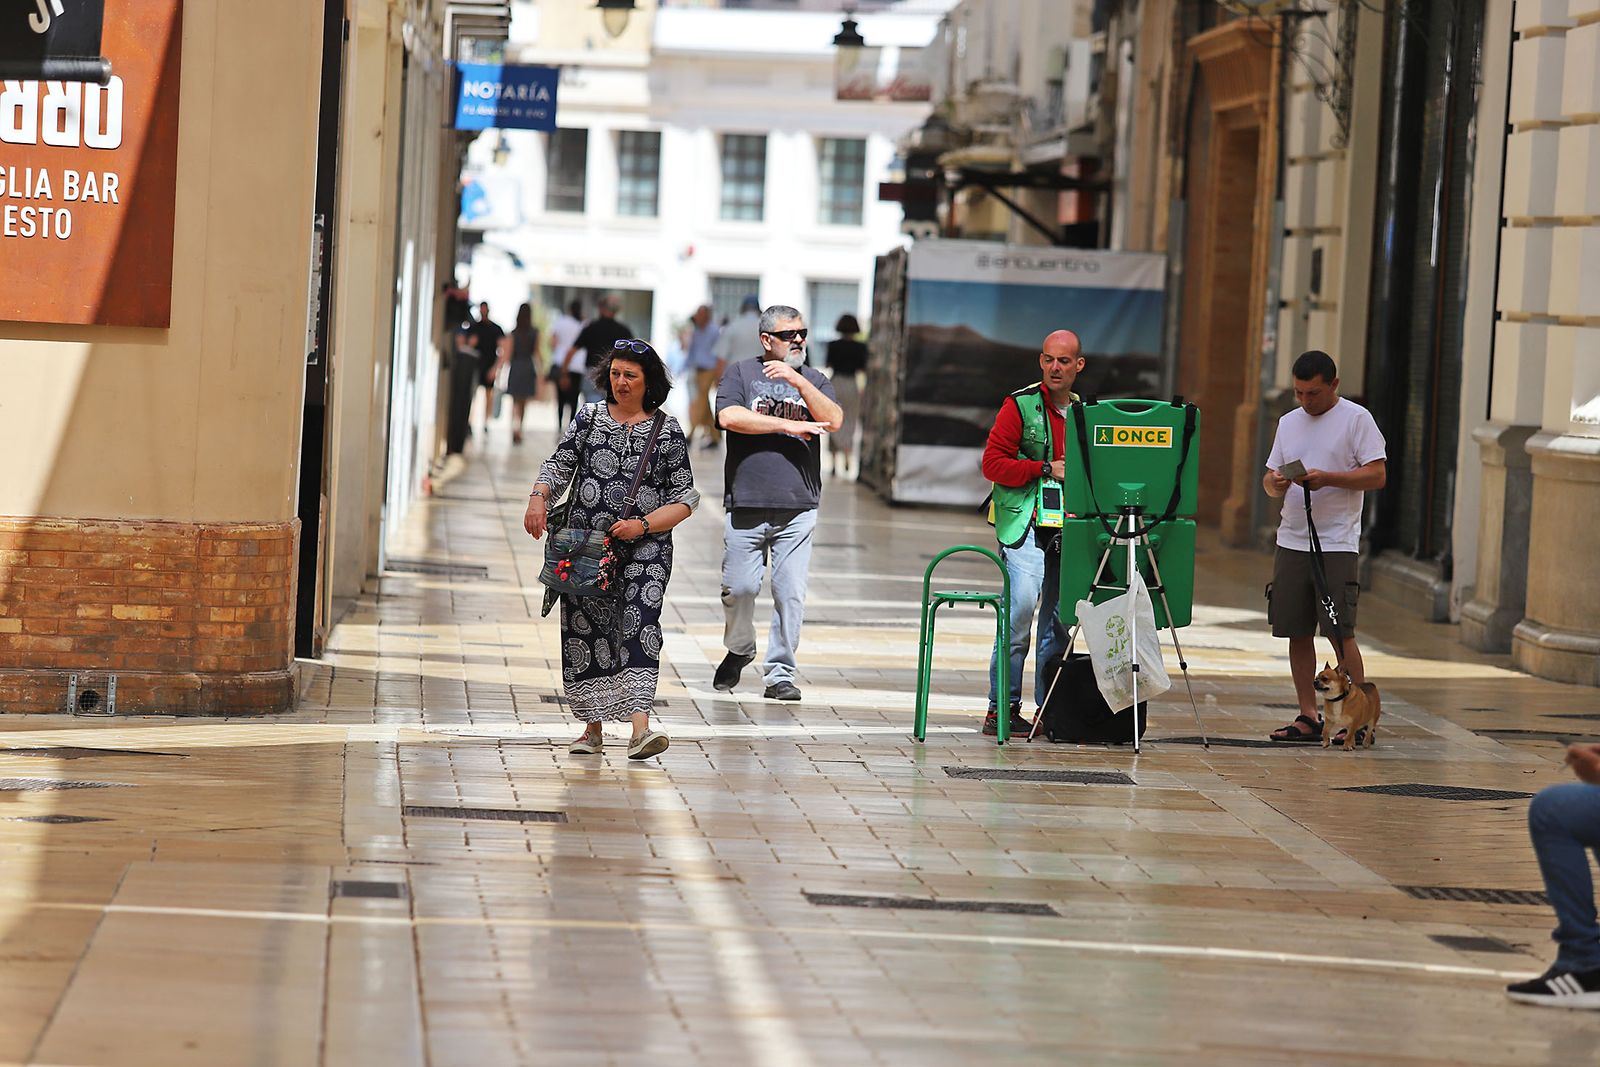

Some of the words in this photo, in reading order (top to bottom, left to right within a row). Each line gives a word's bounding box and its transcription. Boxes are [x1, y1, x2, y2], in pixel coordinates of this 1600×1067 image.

[463, 80, 551, 103] NOTARÍA
[63, 169, 119, 204] BAR
[4, 204, 72, 240] ESTO
[1117, 429, 1167, 443] ONCE
